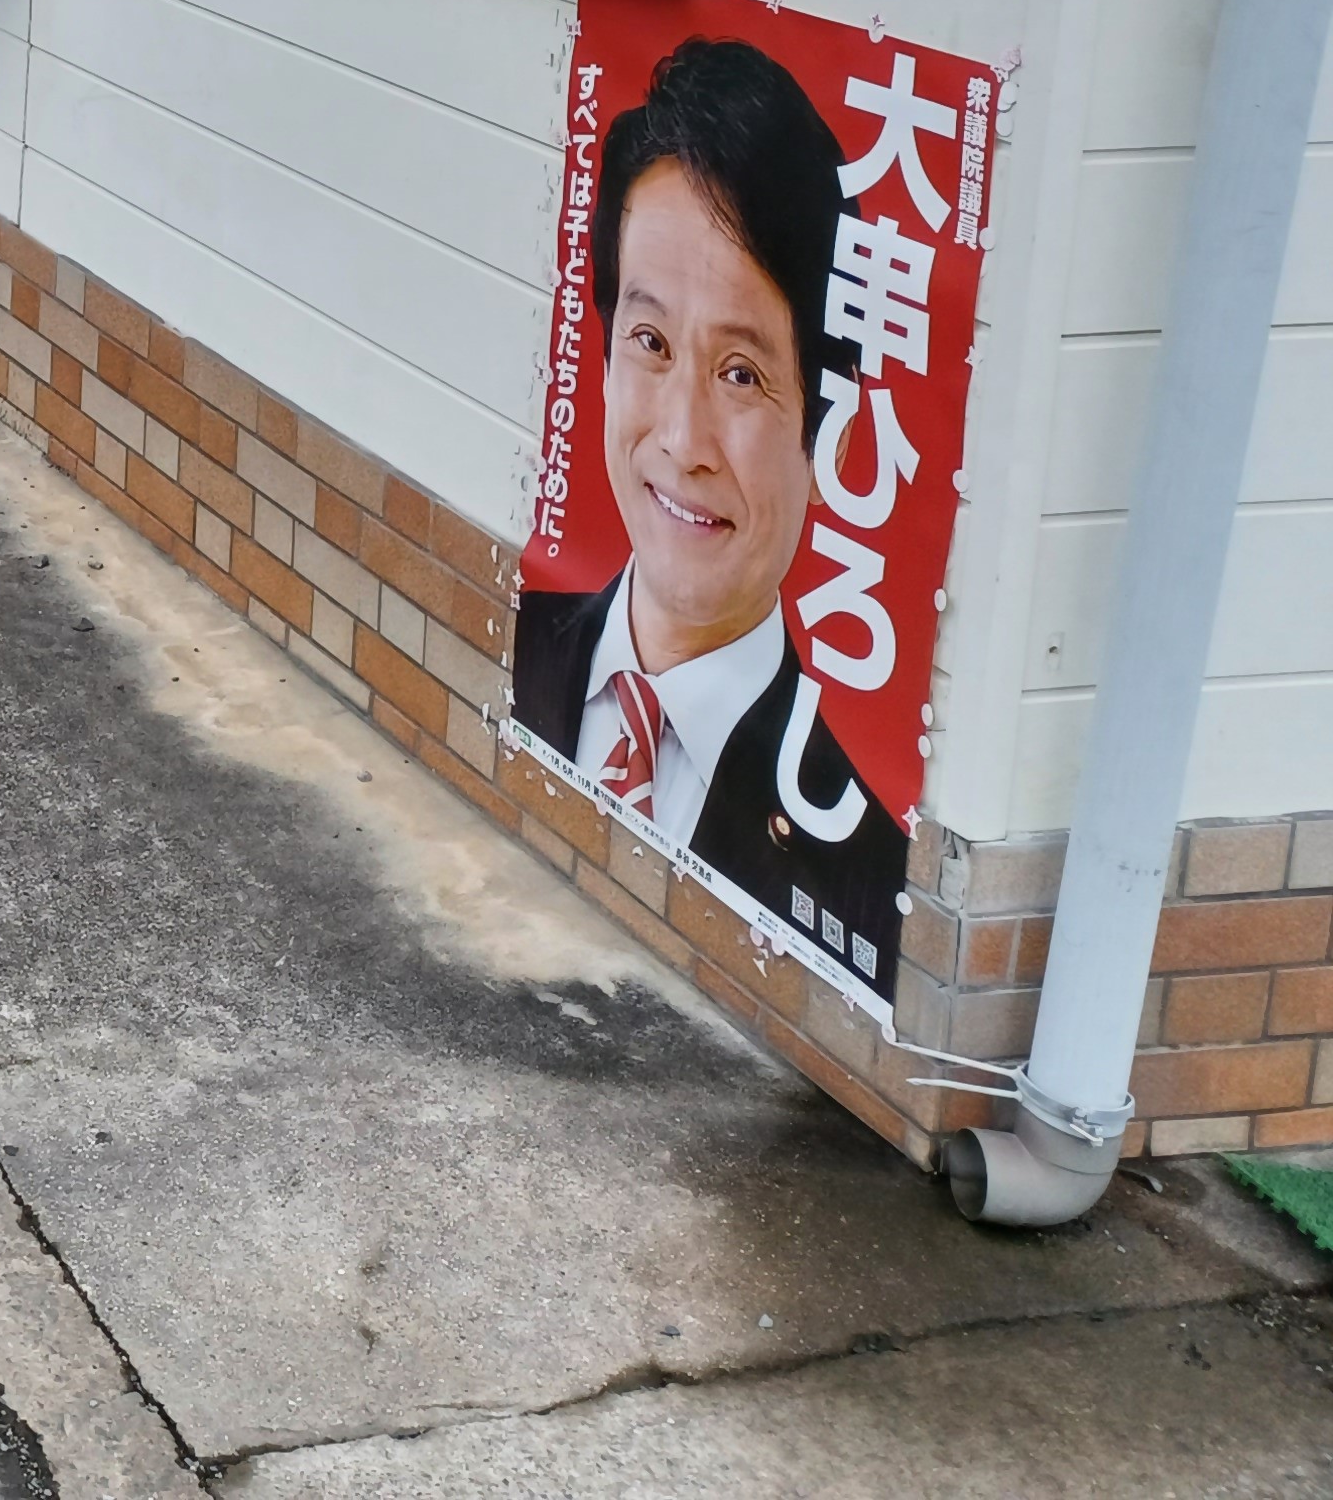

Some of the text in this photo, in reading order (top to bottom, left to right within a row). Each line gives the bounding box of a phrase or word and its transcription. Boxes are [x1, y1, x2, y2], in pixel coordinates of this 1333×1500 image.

[539, 64, 604, 558] すべては子どもたちのために。
[954, 76, 992, 251] 衆議院議員
[775, 53, 958, 843] 大串ひろし
